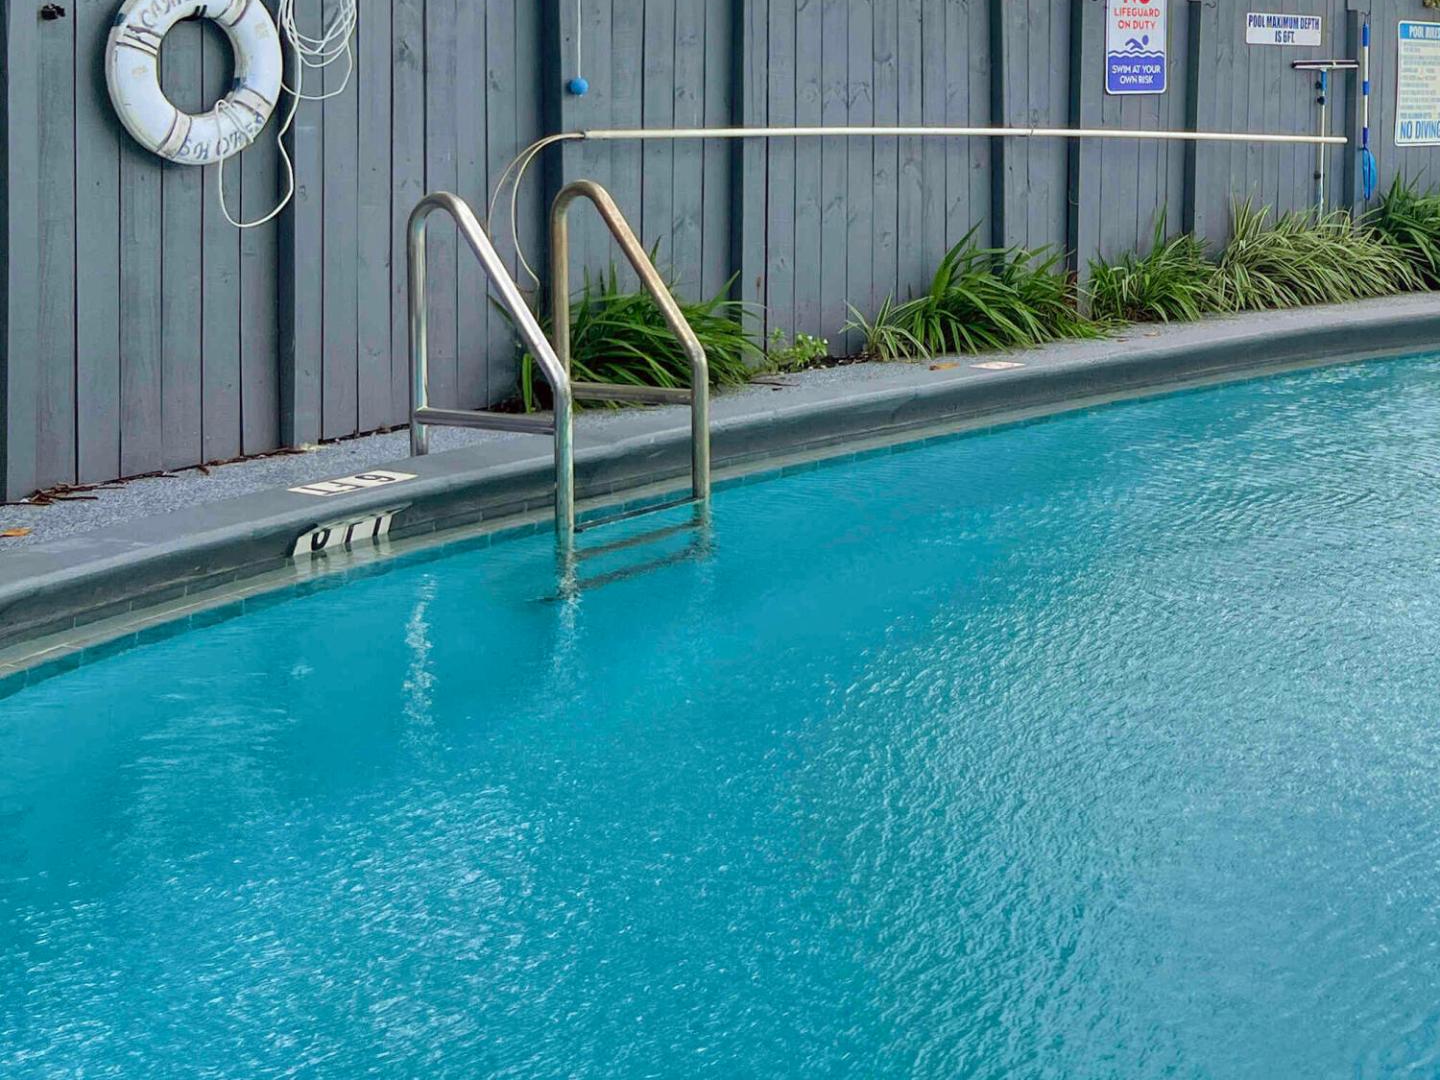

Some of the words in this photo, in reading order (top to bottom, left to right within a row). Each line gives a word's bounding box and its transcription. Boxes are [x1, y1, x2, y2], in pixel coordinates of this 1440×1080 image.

[1113, 7, 1161, 17] LIFEGUARD
[1118, 20, 1131, 29] ON
[1132, 20, 1157, 29] DUTY
[1248, 14, 1265, 28] POOL
[1266, 15, 1299, 30] MAXIMUM
[1300, 16, 1320, 31] DEPTH
[1275, 31, 1282, 43] IS
[1408, 25, 1424, 39] POOL
[1111, 65, 1131, 74] SWIM
[1132, 65, 1141, 73] AT
[1142, 65, 1161, 73] YOUR
[1119, 75, 1137, 85] OWN
[1138, 75, 1154, 85] RISK
[1400, 120, 1412, 139] NO
